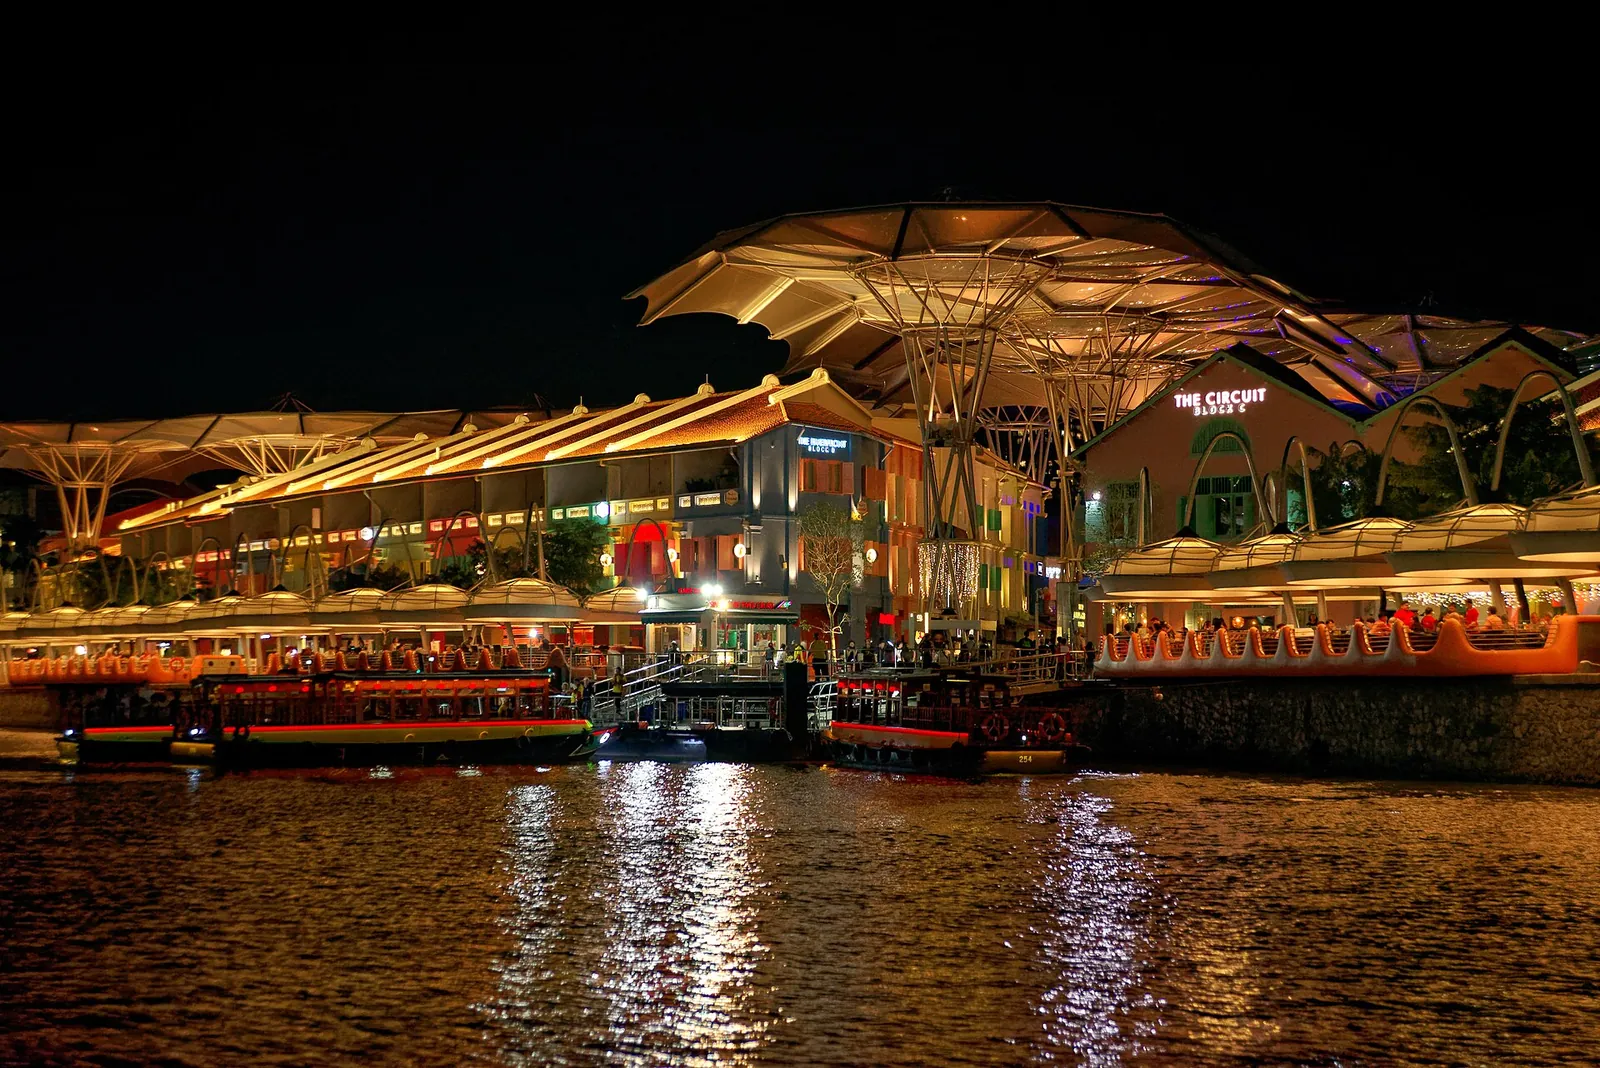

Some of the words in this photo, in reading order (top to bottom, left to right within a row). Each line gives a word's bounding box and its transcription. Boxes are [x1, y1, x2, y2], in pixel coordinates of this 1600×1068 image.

[1174, 393, 1201, 408] THE
[1205, 388, 1266, 405] CIRCUIT
[1193, 404, 1233, 416] BLOCK
[1019, 755, 1032, 763] 254
